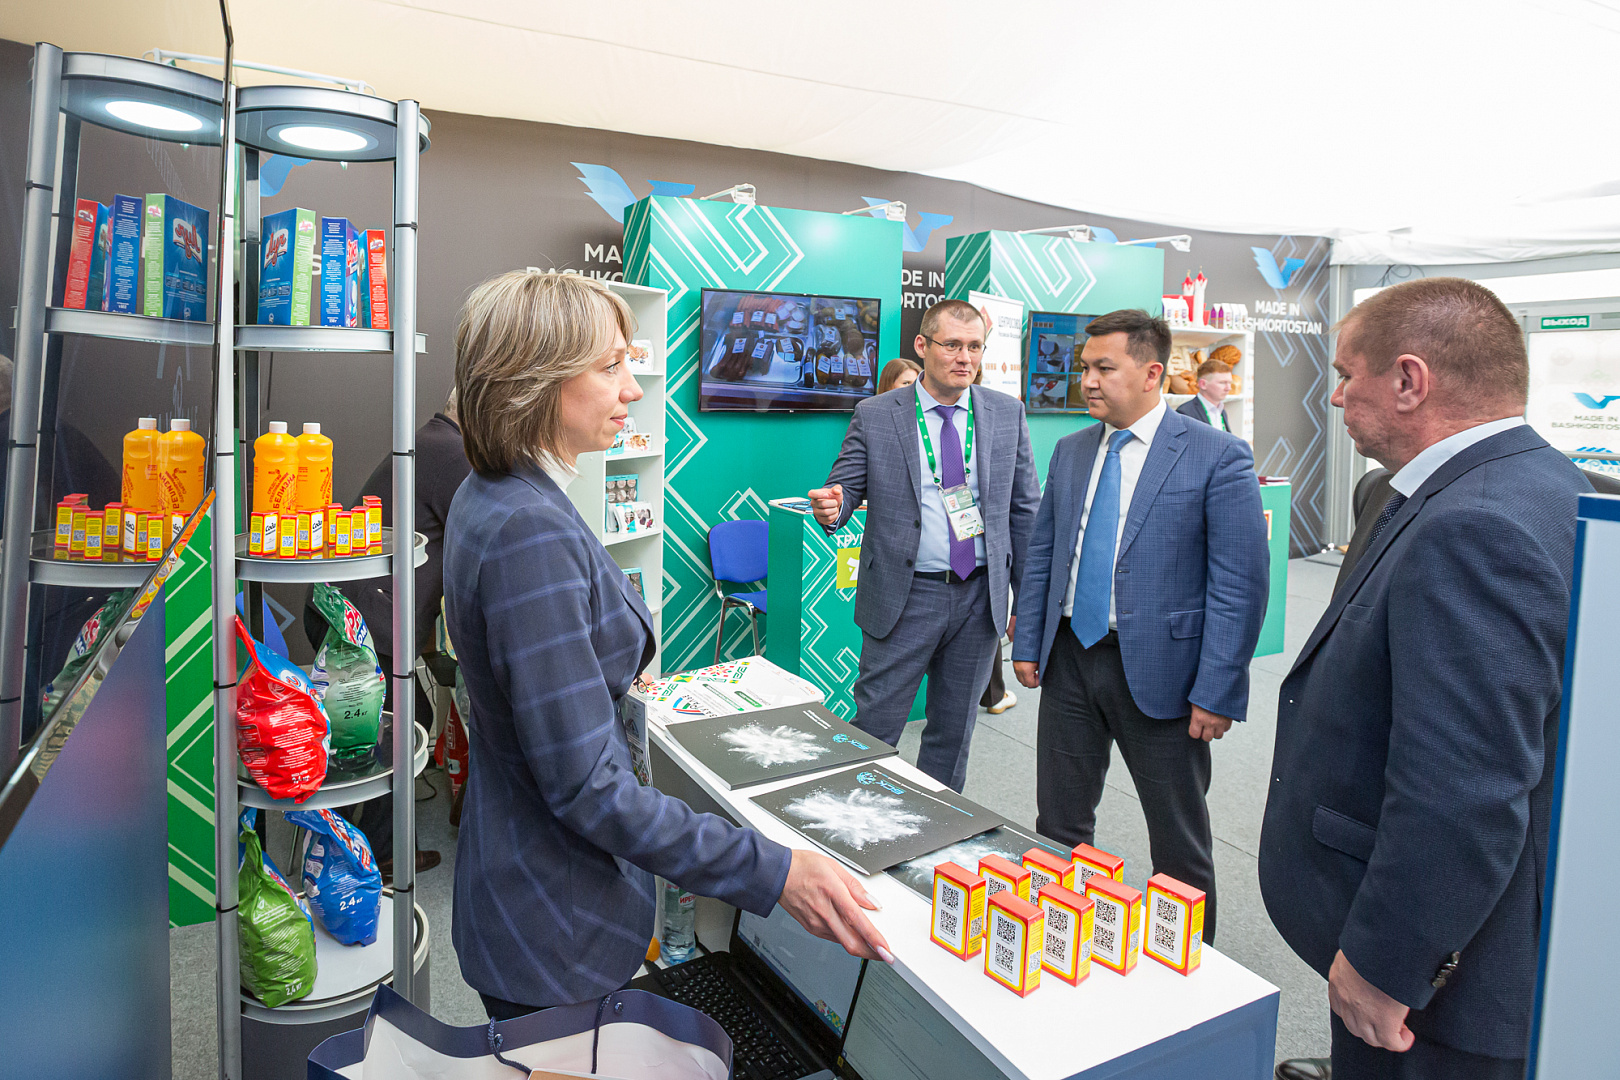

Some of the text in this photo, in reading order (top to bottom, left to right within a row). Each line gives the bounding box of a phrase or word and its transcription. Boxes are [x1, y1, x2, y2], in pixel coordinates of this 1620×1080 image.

[584, 243, 623, 264] MA
[901, 269, 945, 288] DE IN
[1255, 300, 1300, 317] MADE IN
[1542, 318, 1587, 327] ВЫХОД
[344, 708, 361, 720] 2.4
[339, 897, 356, 911] 2.4
